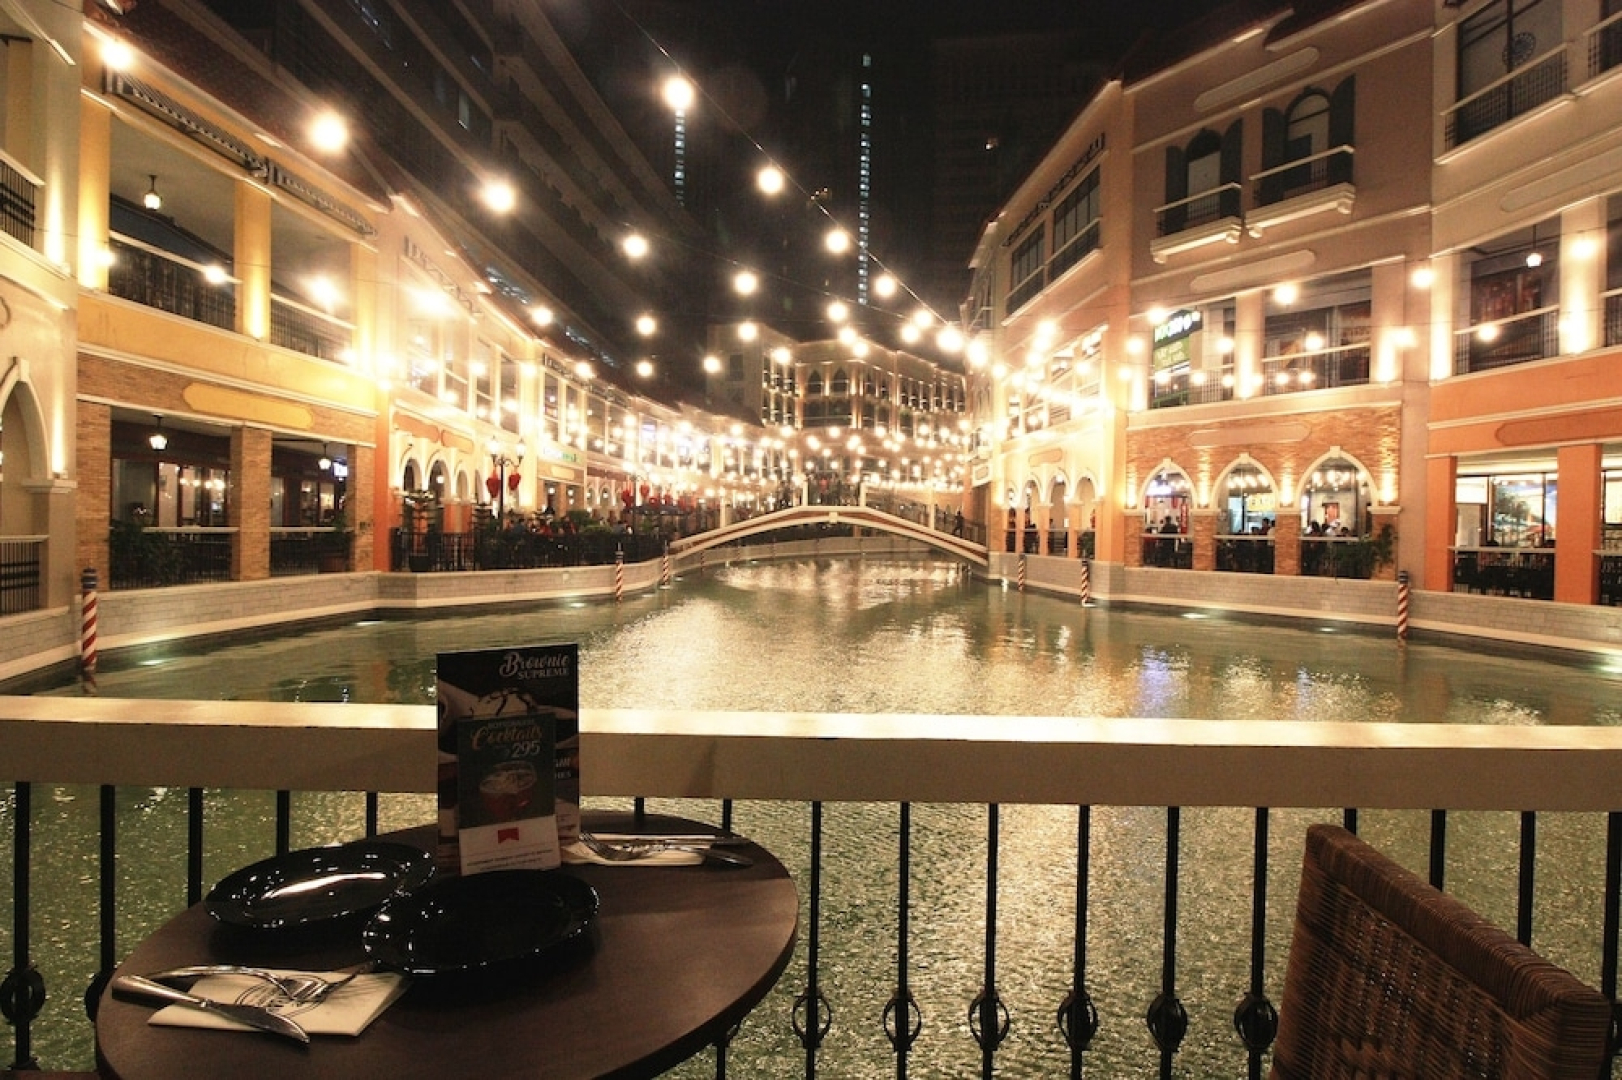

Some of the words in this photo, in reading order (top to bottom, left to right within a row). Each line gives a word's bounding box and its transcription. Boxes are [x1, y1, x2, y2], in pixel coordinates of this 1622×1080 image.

[499, 651, 570, 677] Brownie
[518, 667, 569, 680] SUPREME
[511, 740, 541, 758] 295
